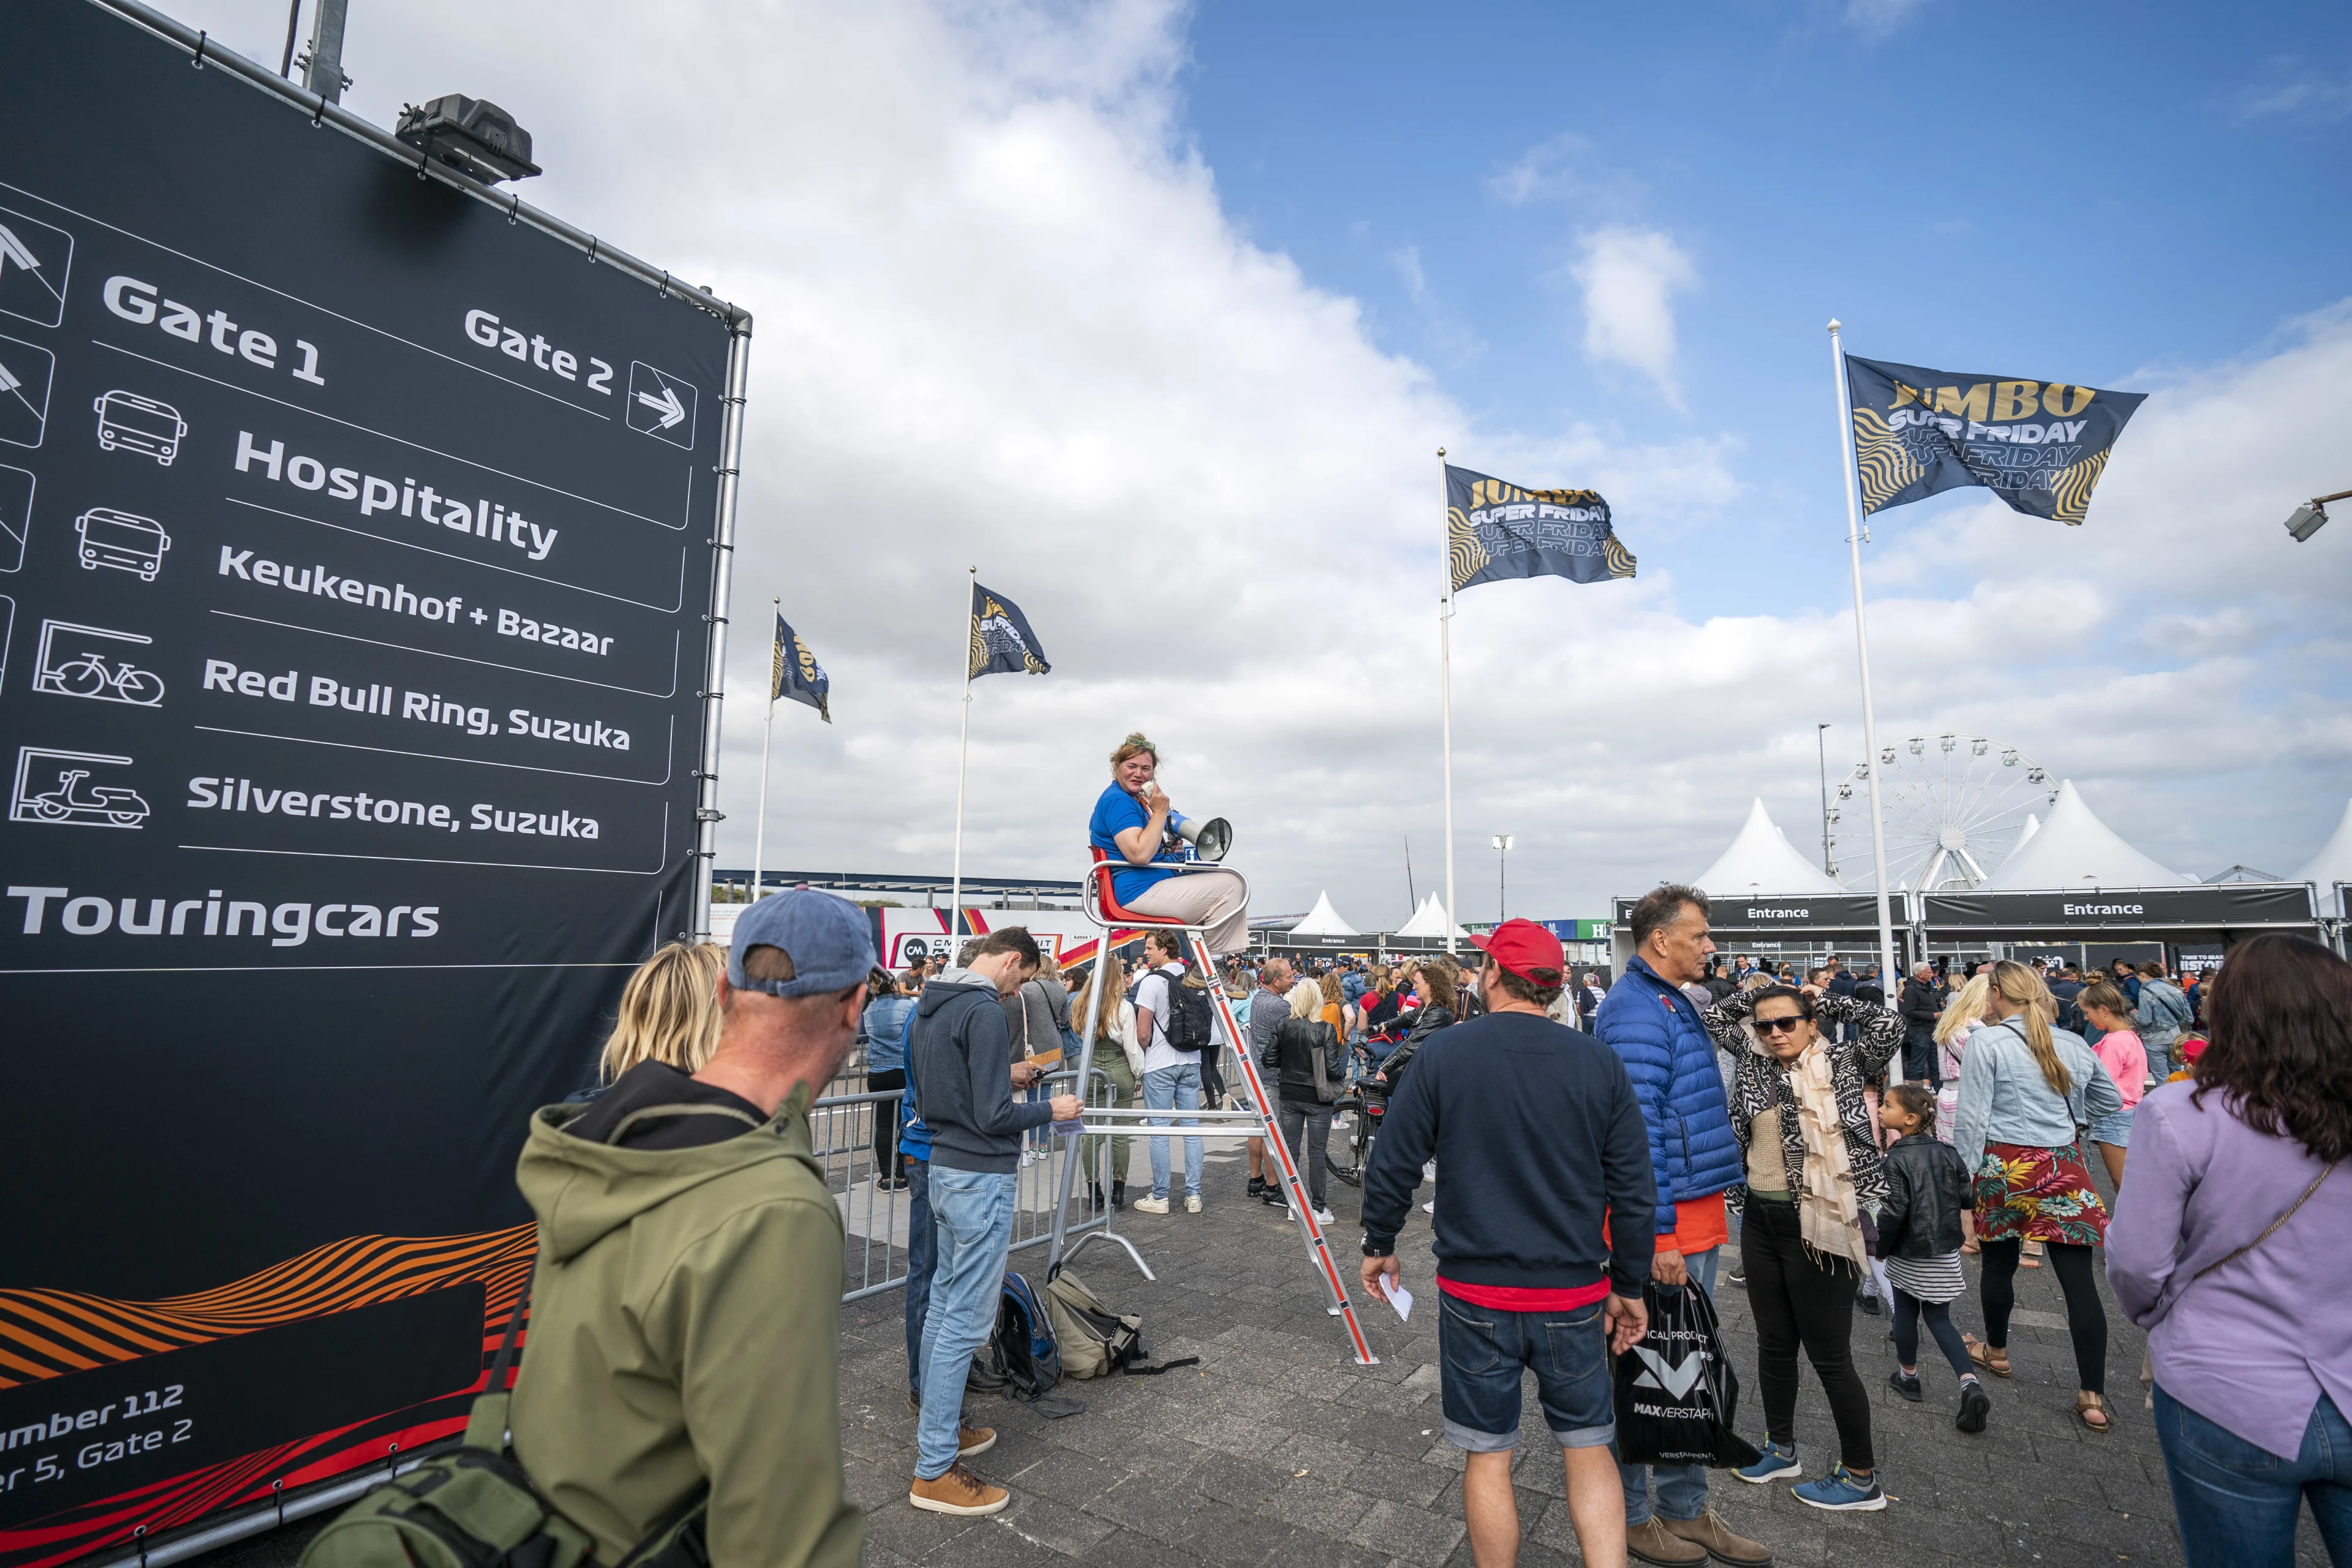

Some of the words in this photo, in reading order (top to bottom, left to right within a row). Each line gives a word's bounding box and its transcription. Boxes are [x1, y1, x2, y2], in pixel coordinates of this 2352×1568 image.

[104, 276, 277, 369] Gate
[292, 339, 325, 386] 1
[465, 309, 578, 382] Gate
[587, 357, 614, 396] 2
[1966, 420, 2088, 444] FRIDAY
[235, 430, 559, 560] Hospitality
[1469, 504, 1536, 528] SUPER
[1539, 504, 1605, 522] FRIDAY
[1537, 520, 1608, 539] FRIDAY
[218, 545, 462, 624] Keukenhof
[469, 607, 488, 625] +
[497, 608, 614, 656] Bazaar
[203, 658, 298, 702] Red
[309, 676, 393, 717] Bull
[402, 690, 498, 736] Ring,
[508, 709, 630, 751] Suzuka
[187, 777, 461, 833] Silverstone,
[470, 804, 599, 839] Suzuka
[7, 886, 440, 947] Touringcars
[1747, 908, 1809, 919] Entrance
[2064, 903, 2143, 916] Entrance
[0, 1404, 116, 1452] mber
[123, 1384, 184, 1419] 112
[35, 1454, 65, 1482] 5,
[77, 1430, 164, 1469] Gate
[172, 1419, 193, 1443] 2
